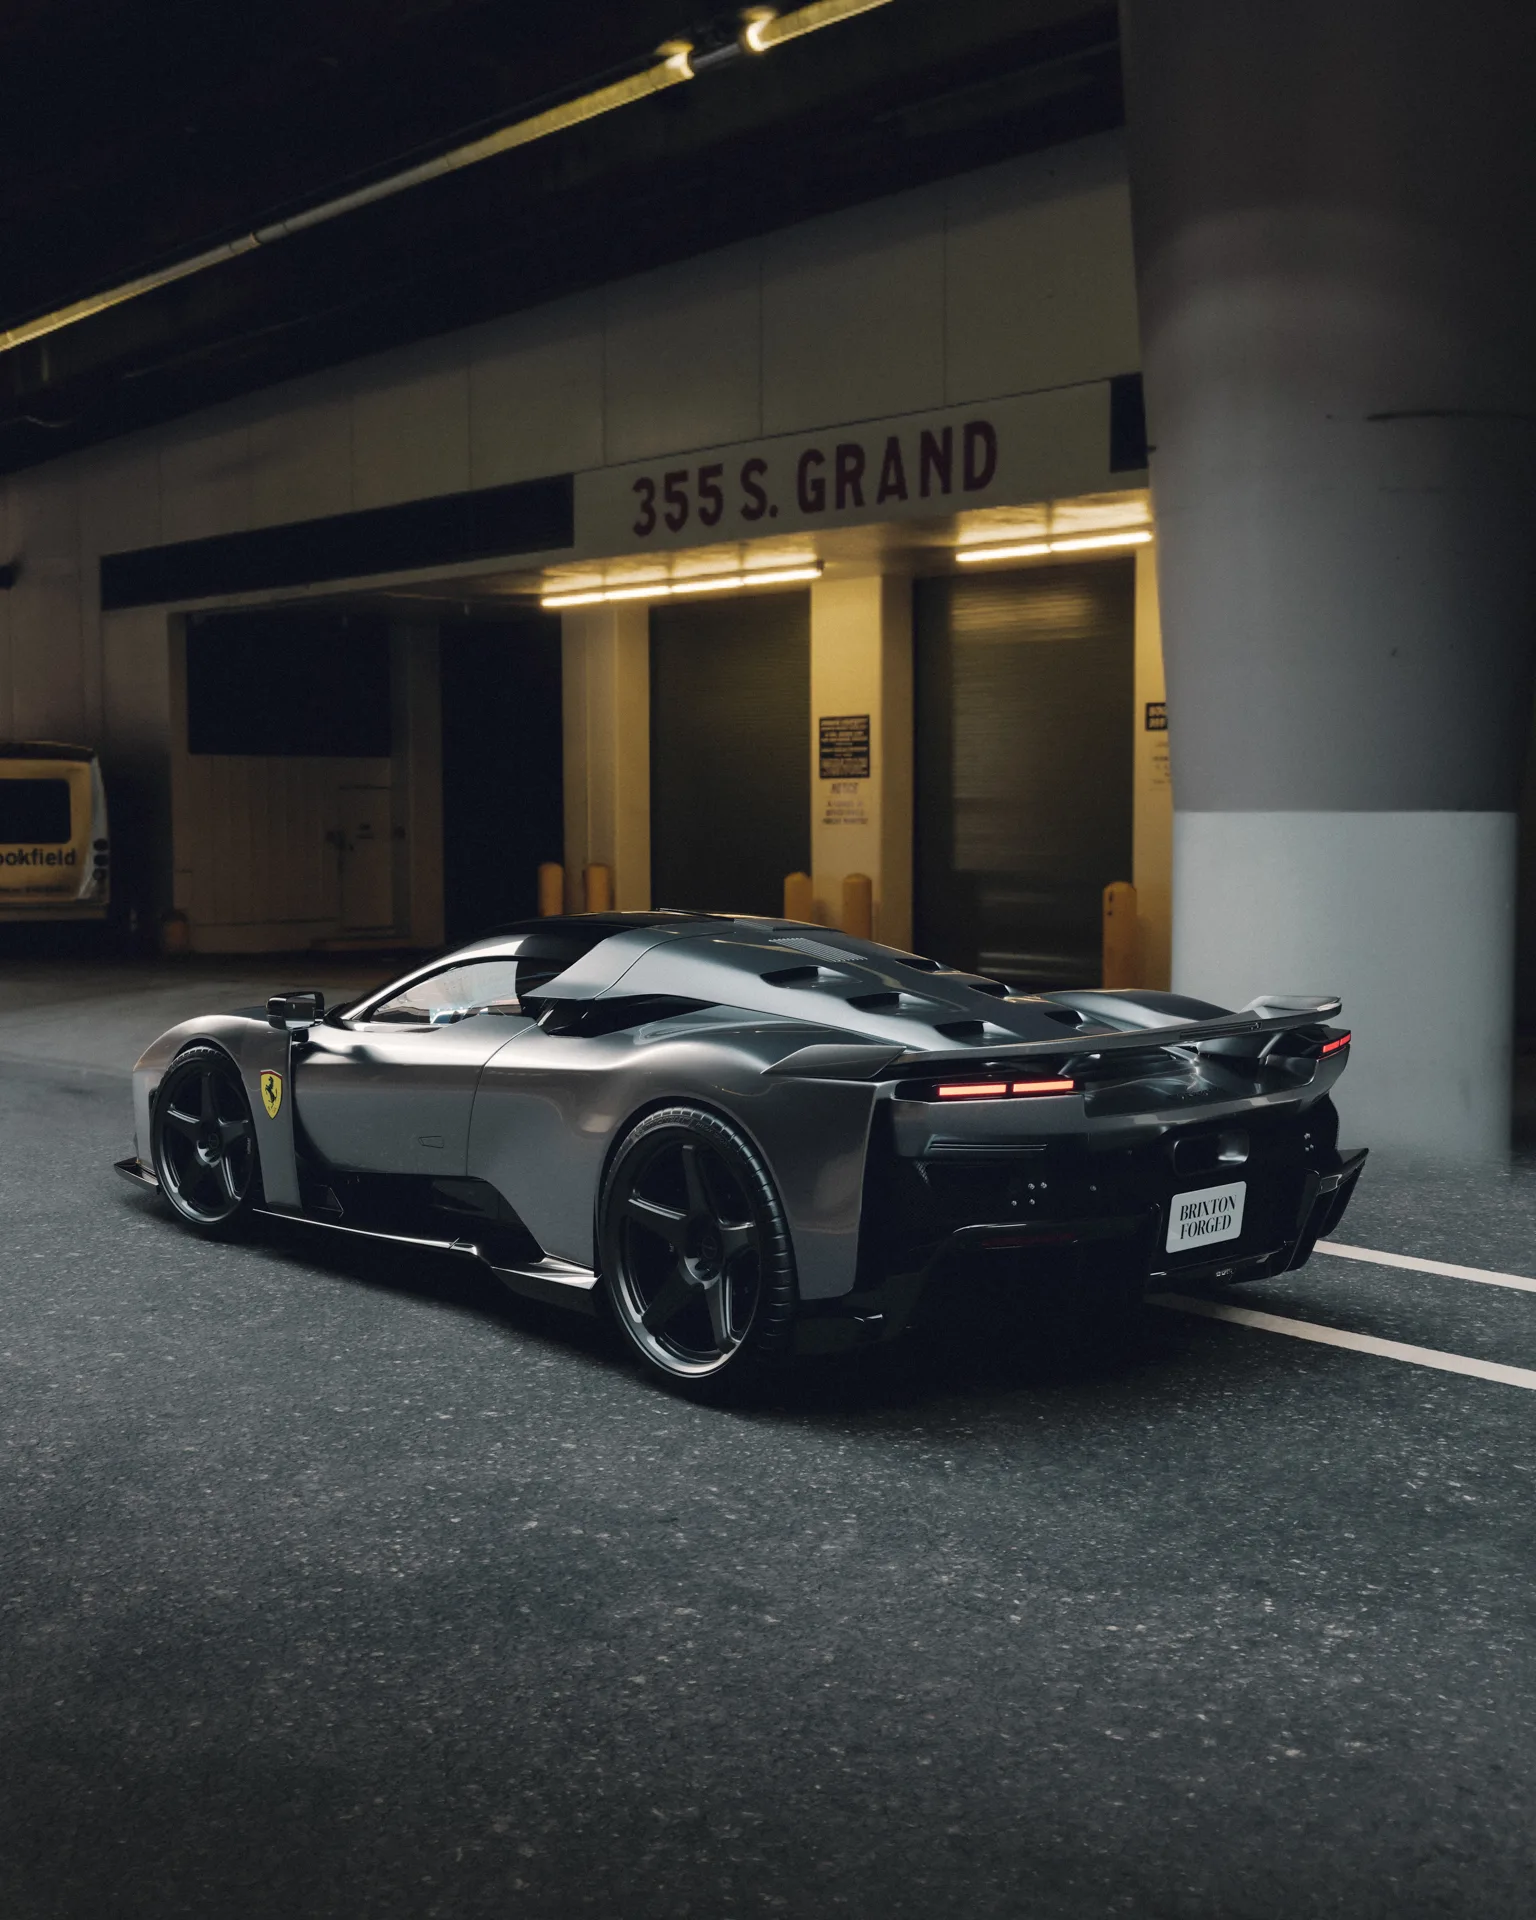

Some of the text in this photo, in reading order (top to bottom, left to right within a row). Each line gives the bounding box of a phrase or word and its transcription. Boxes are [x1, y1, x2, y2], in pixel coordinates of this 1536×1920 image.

[633, 420, 998, 536] 355 S. GRAND
[1180, 1195, 1237, 1221] BRIXTON
[1180, 1214, 1232, 1240] FORGED
